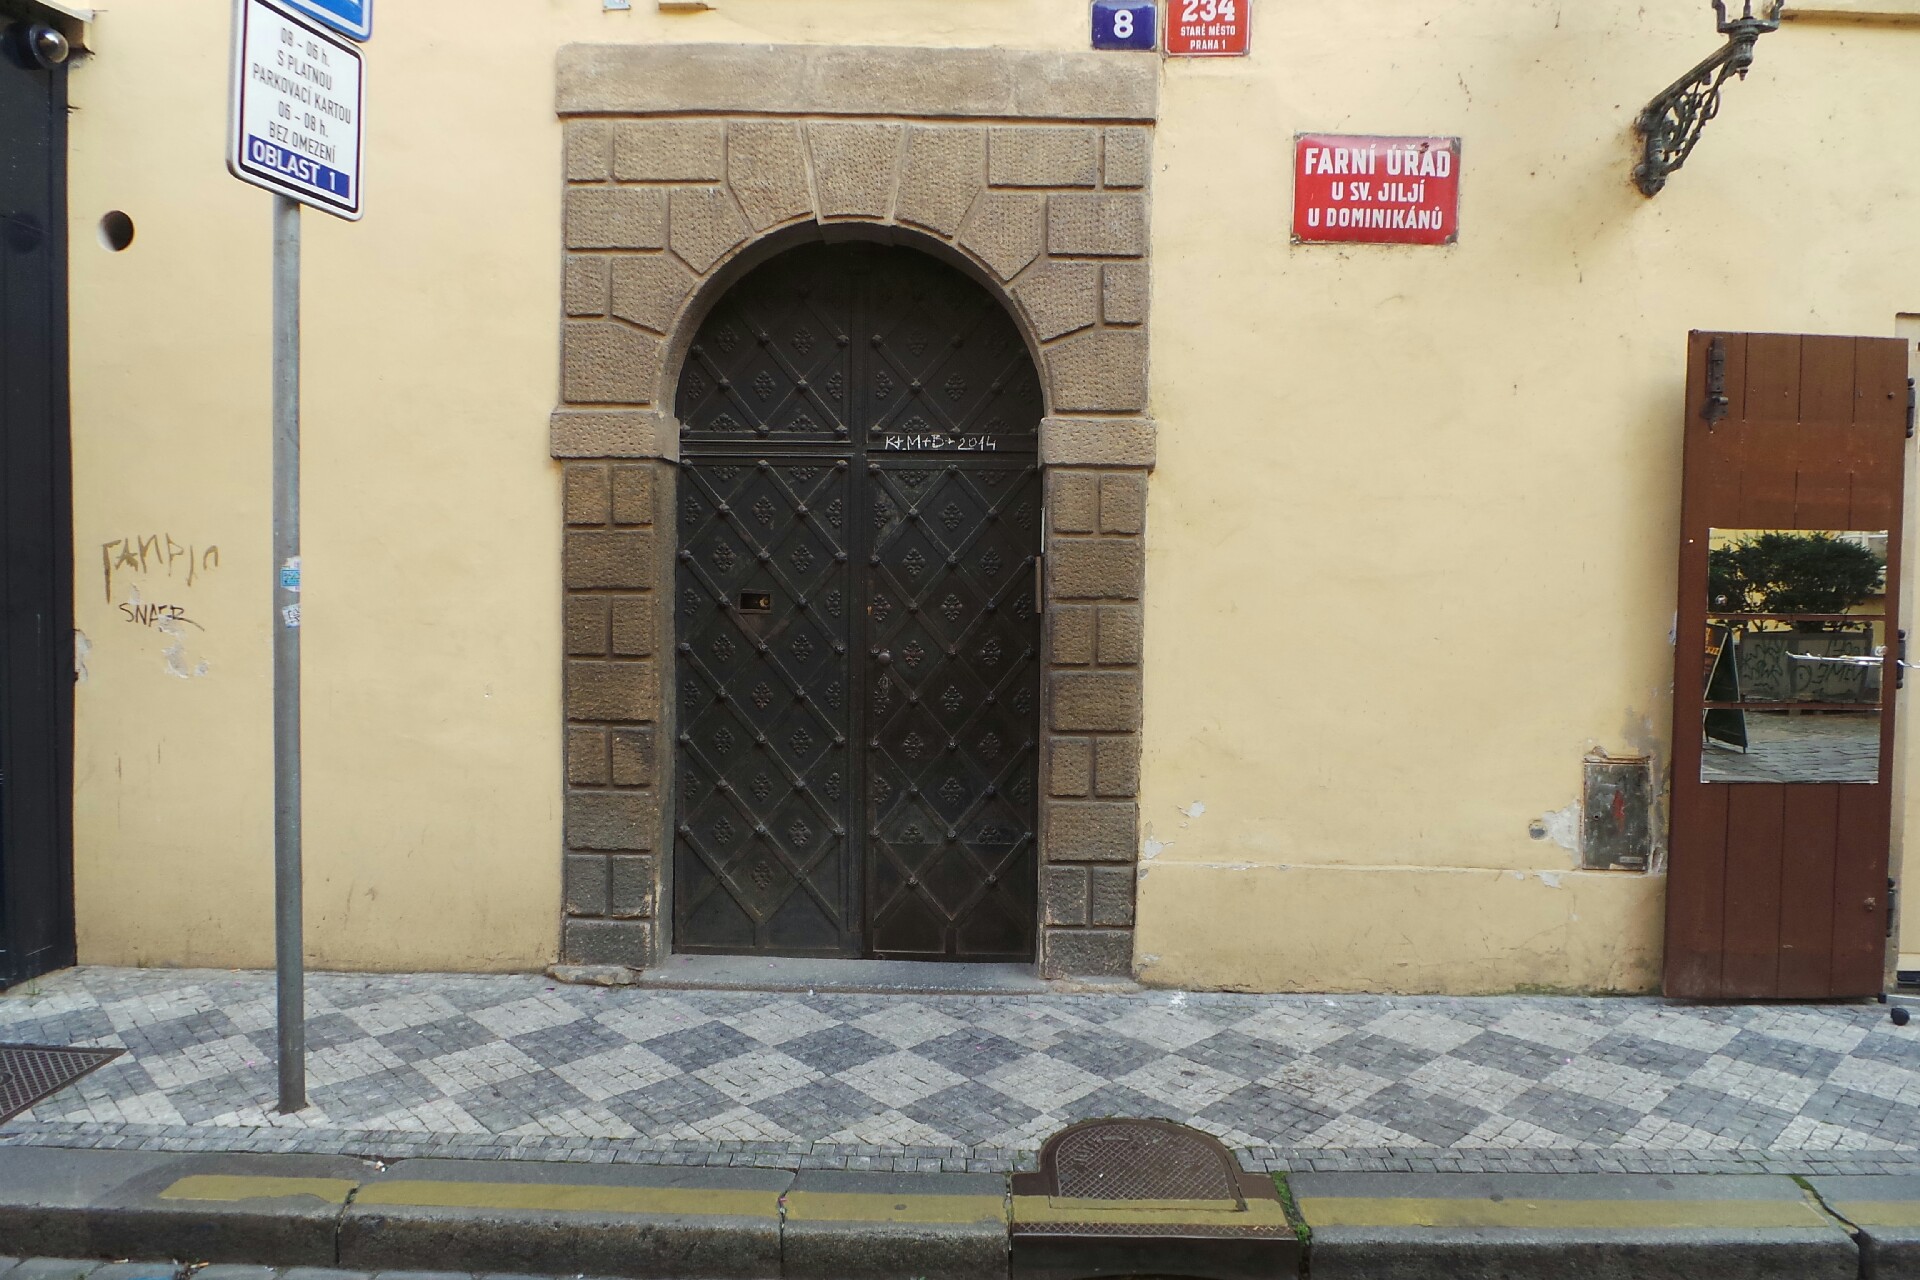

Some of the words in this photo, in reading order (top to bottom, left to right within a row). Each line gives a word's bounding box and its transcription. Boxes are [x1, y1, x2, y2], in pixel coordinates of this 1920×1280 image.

[1113, 10, 1134, 39] 8
[1181, 0, 1236, 22] 234
[281, 27, 294, 47] 08
[306, 40, 319, 60] 06
[1180, 23, 1206, 36] STARÉ
[1208, 22, 1236, 36] MĚSTO
[1190, 39, 1219, 50] PRAHA
[1222, 39, 1226, 50] 1
[277, 49, 284, 66] S
[288, 54, 332, 91] PLATNOU
[253, 62, 312, 105] PARKOVACÍ
[315, 92, 351, 124] KARTOU
[278, 100, 291, 120] 06
[304, 112, 316, 132] 08
[319, 119, 329, 138] h.
[269, 120, 288, 144] BEZ
[292, 131, 336, 164] OMEZENÍ
[252, 140, 320, 185] OBLAST
[329, 171, 336, 190] 1
[1305, 143, 1377, 175] FARNÍ
[1331, 181, 1344, 200] U
[1350, 181, 1372, 201] SV.
[1377, 179, 1426, 203] JILJÍ
[1308, 207, 1320, 227] U
[1326, 205, 1443, 230] DOMINIKÁNŮ
